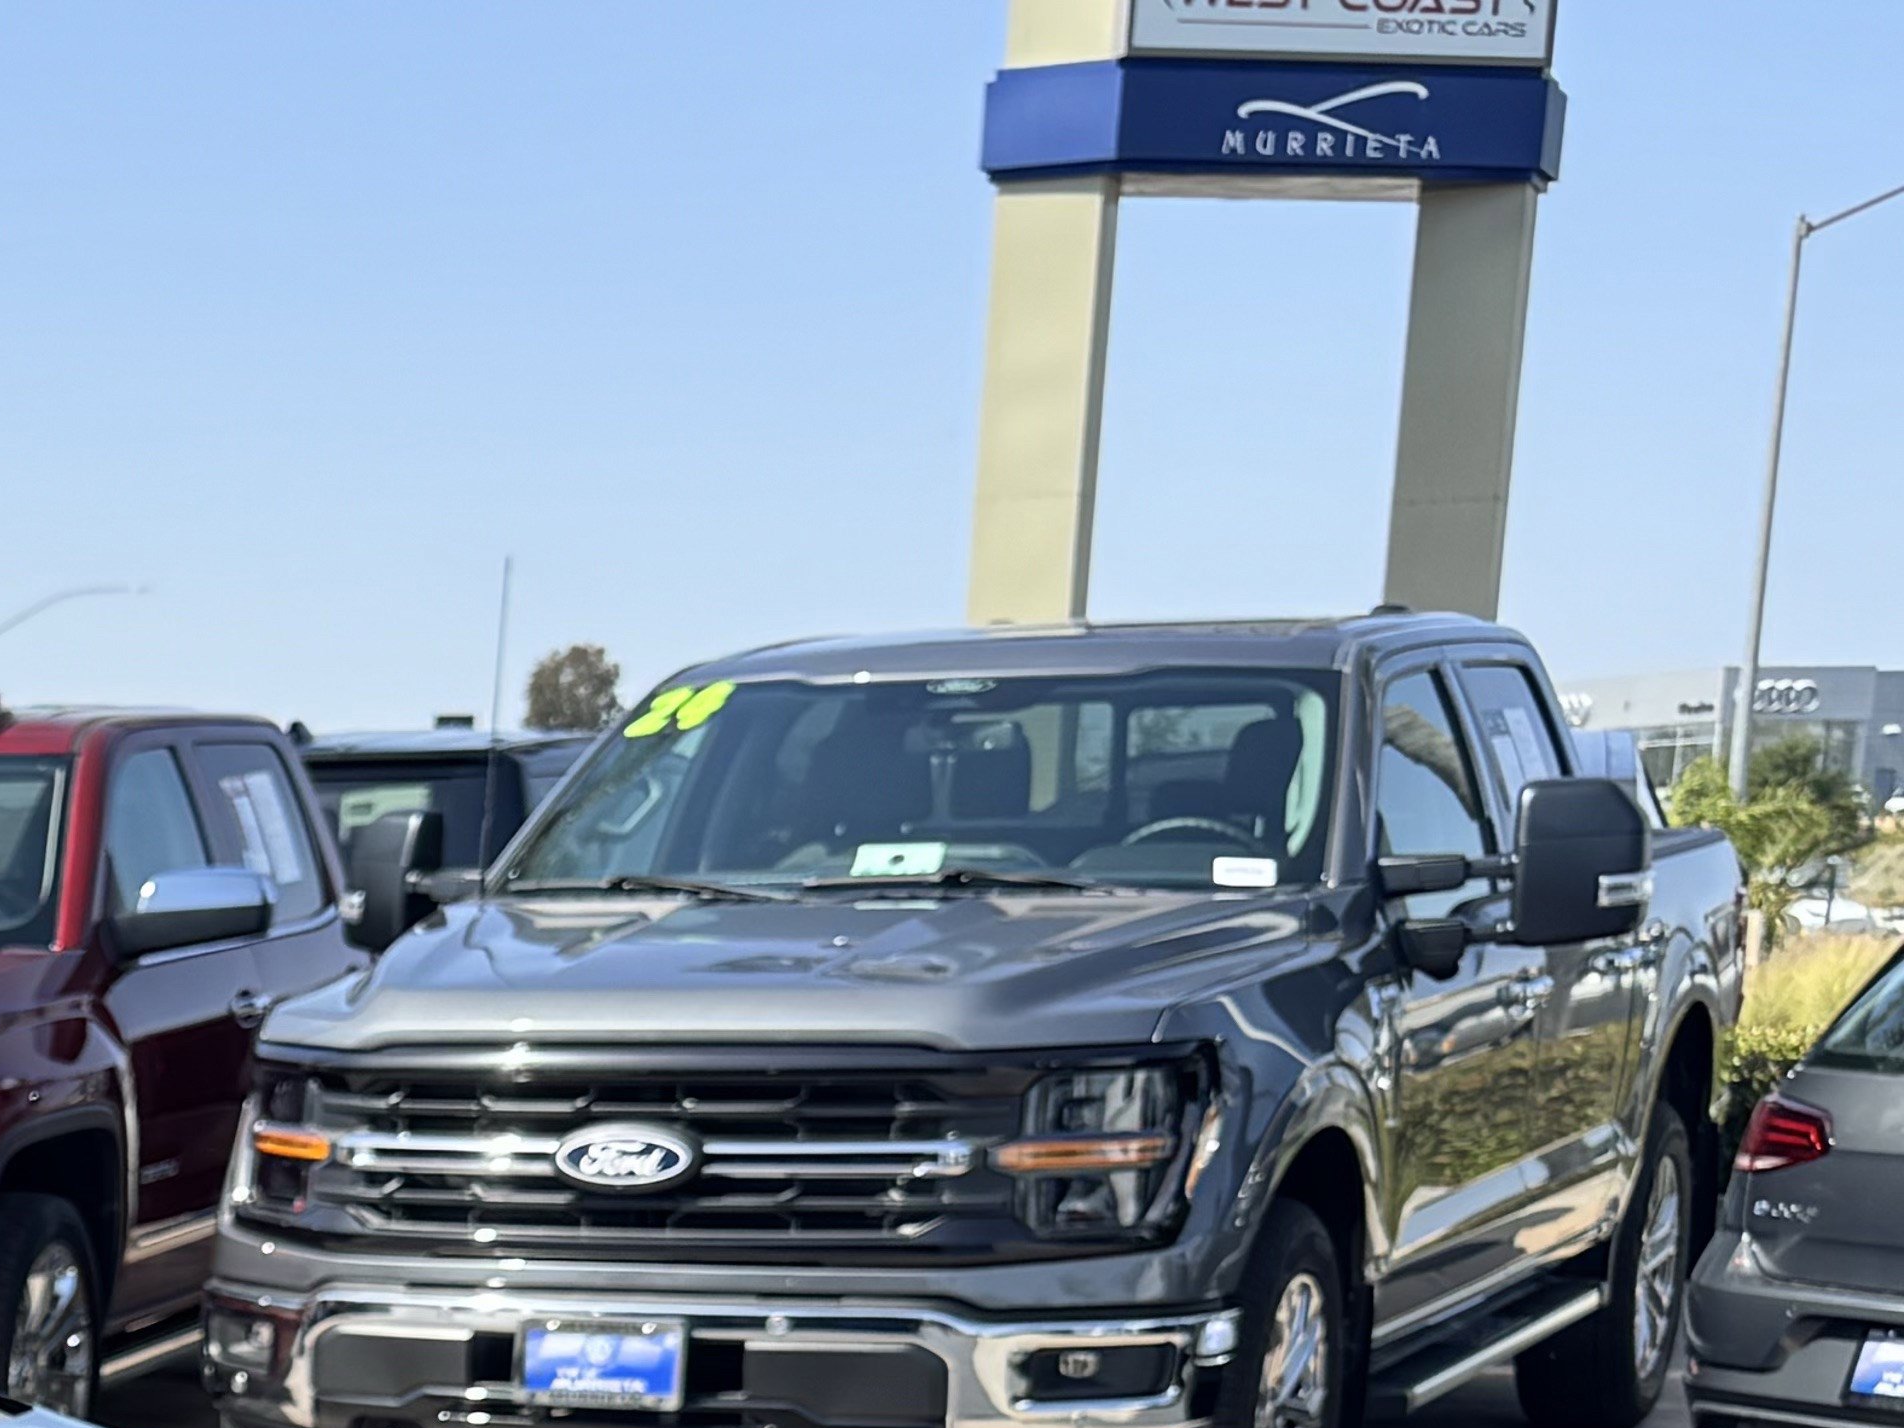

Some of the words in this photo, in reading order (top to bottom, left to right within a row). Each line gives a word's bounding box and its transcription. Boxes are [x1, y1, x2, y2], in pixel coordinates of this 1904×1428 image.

[1376, 18, 1458, 36] EXOTIC
[1461, 20, 1528, 38] CARS
[1221, 129, 1441, 160] MURRIETA
[578, 1141, 665, 1176] Ford
